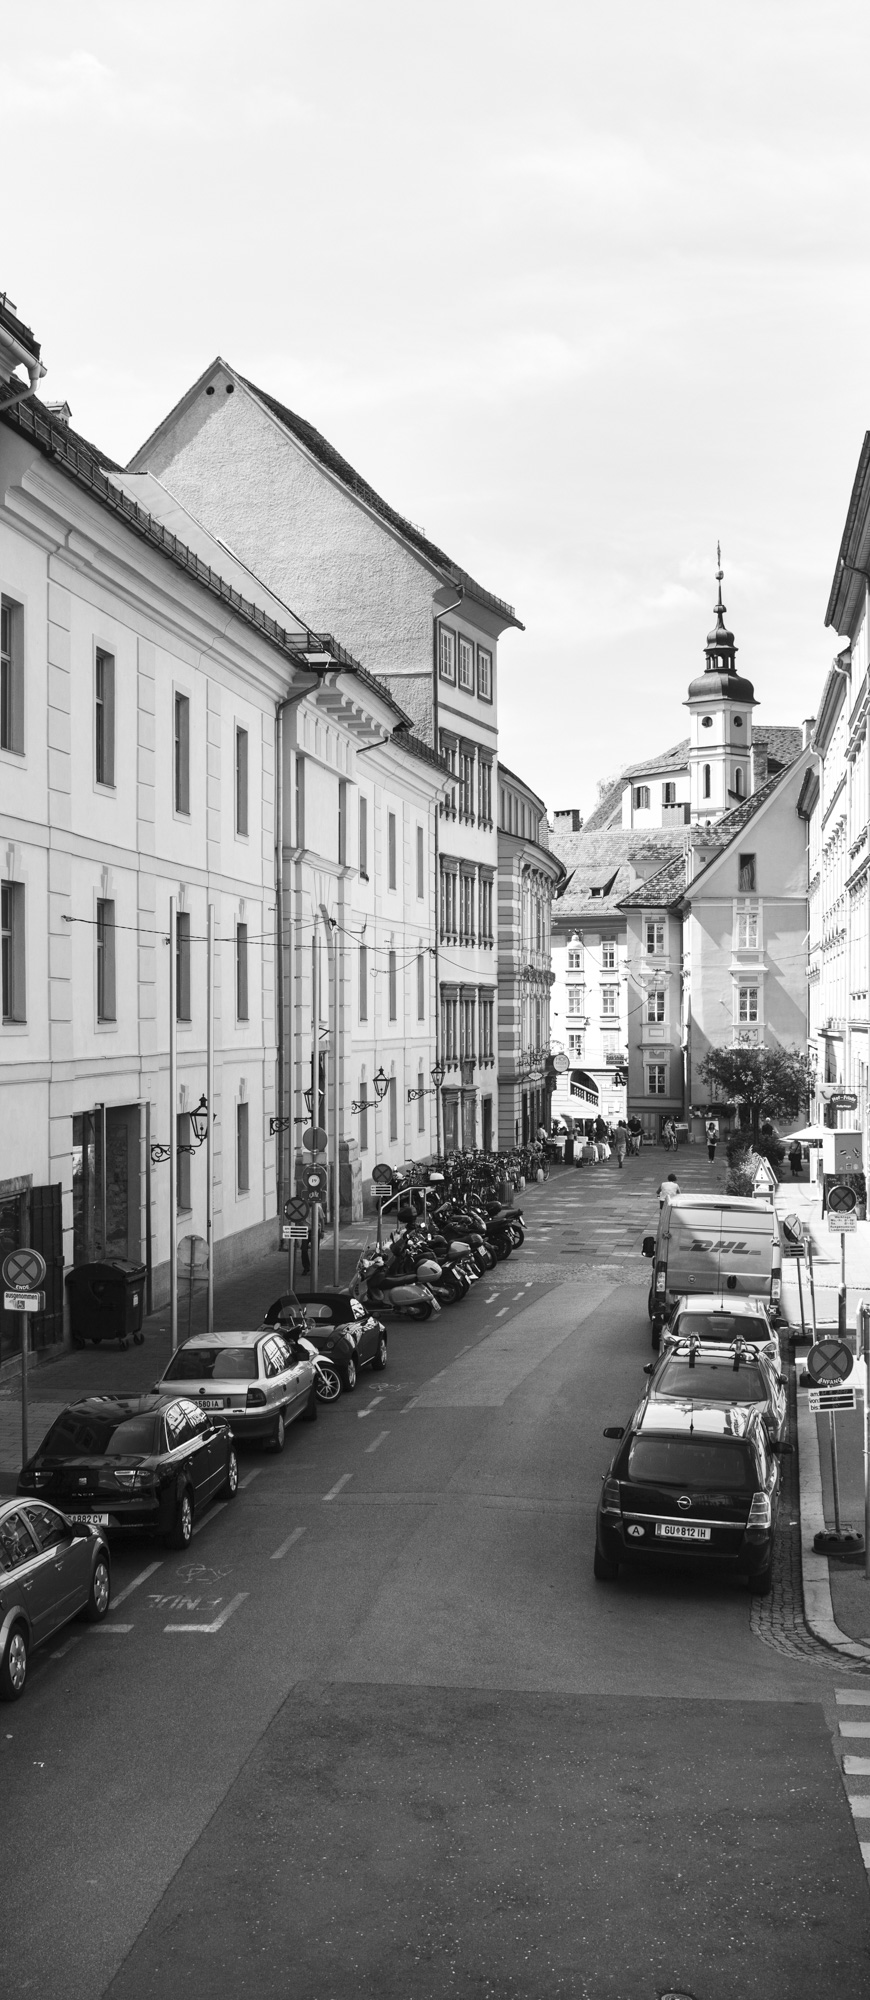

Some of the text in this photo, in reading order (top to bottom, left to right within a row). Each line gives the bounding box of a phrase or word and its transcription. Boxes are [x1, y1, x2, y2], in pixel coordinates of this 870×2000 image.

[690, 1239, 750, 1254] DHL
[5, 1292, 38, 1300] ausgenommen
[817, 1377, 843, 1385] ANFANG
[632, 1526, 640, 1535] A
[680, 1527, 696, 1537] 812
